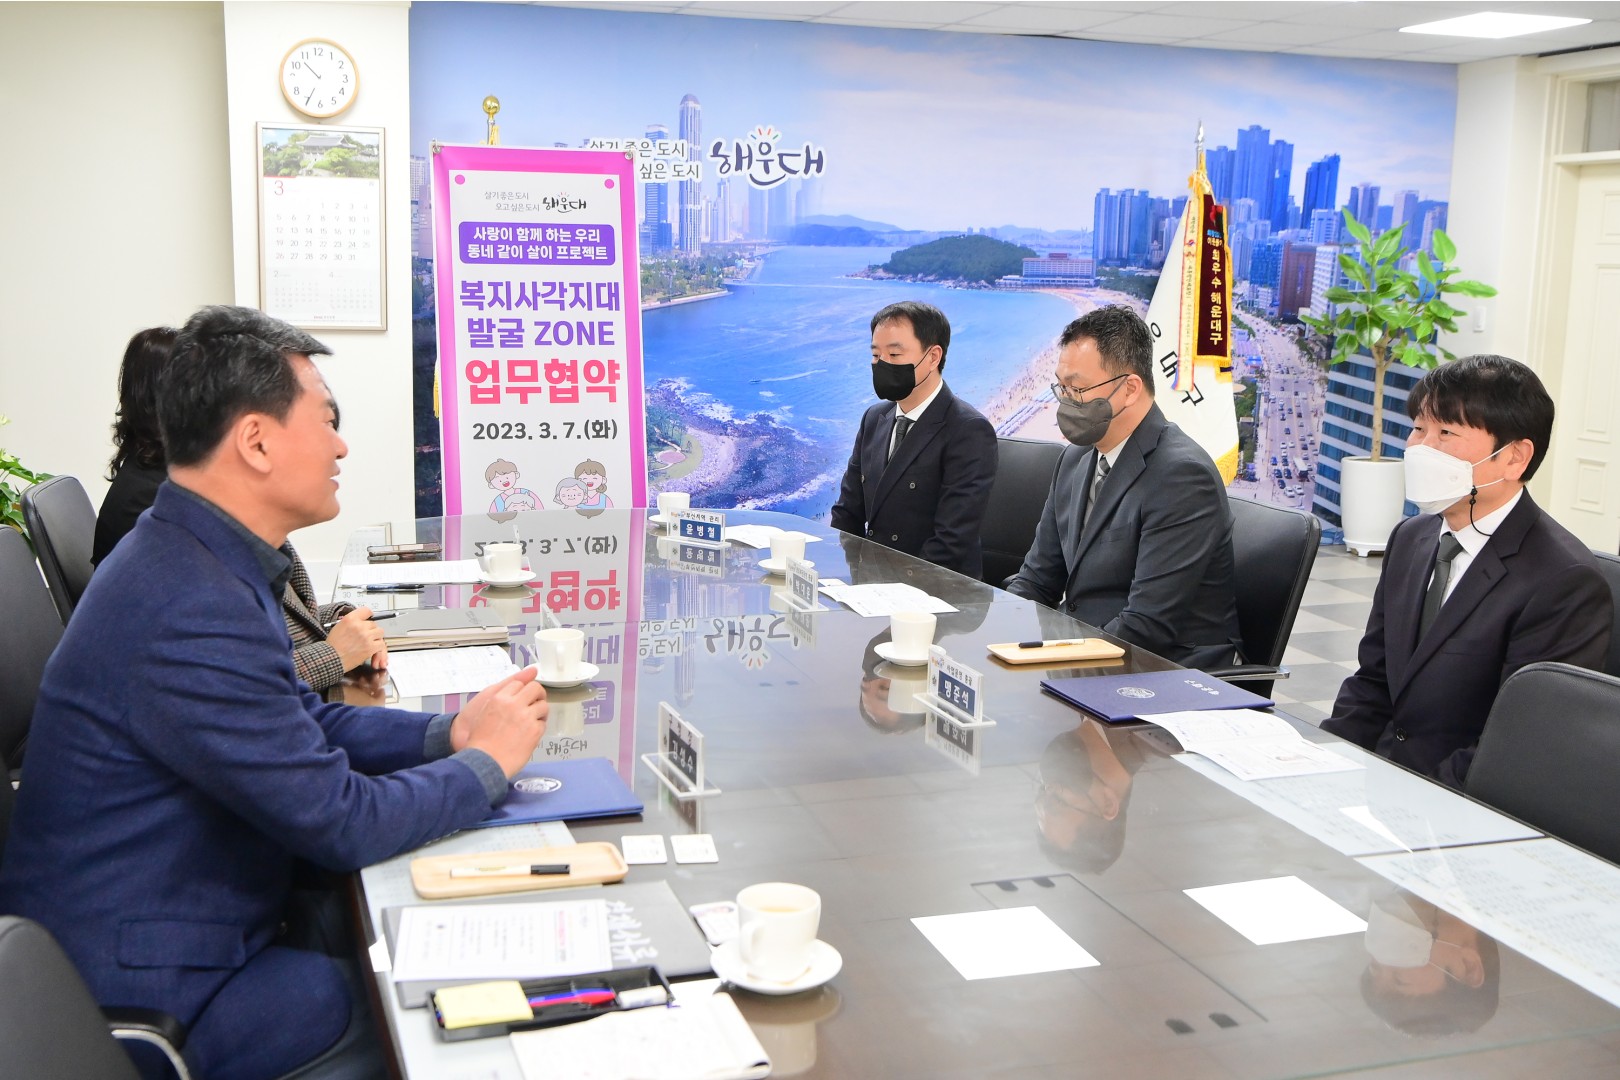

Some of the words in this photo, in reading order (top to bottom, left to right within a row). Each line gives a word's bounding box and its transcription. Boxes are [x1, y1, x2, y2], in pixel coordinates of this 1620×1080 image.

[302, 52, 308, 60] 11
[314, 48, 323, 56] 12
[330, 52, 333, 60] 1
[292, 61, 300, 69] 10
[338, 61, 344, 69] 2
[343, 74, 348, 83] 3
[294, 86, 299, 95] 8
[318, 100, 323, 108] 6
[331, 96, 336, 105] 5
[657, 141, 685, 157] 도시
[710, 141, 823, 186] 해운대
[640, 164, 667, 180] 싶은
[672, 164, 699, 179] 도시
[274, 180, 284, 195] 3
[484, 191, 500, 200] 살기
[501, 192, 515, 200] 좋은
[515, 192, 529, 200] 도시
[495, 203, 510, 212] 오고
[525, 204, 540, 212] 도시
[542, 196, 587, 213] 해운대
[474, 227, 513, 241] 사랑이
[516, 227, 542, 242] 함께
[546, 228, 572, 242] 하는
[575, 228, 600, 243] 우리
[468, 244, 494, 259] 동네
[496, 244, 523, 259] 같이
[526, 245, 552, 260] 살이
[556, 246, 608, 260] 프로젝트
[1211, 249, 1222, 288] 최우수
[460, 281, 620, 311] 복지사각지대
[1210, 292, 1223, 345] 해운대구
[467, 318, 524, 348] 발굴
[534, 321, 615, 346] ZONE
[465, 359, 620, 404] 업무협약
[472, 422, 533, 440] 2023.
[539, 422, 557, 440] 3.
